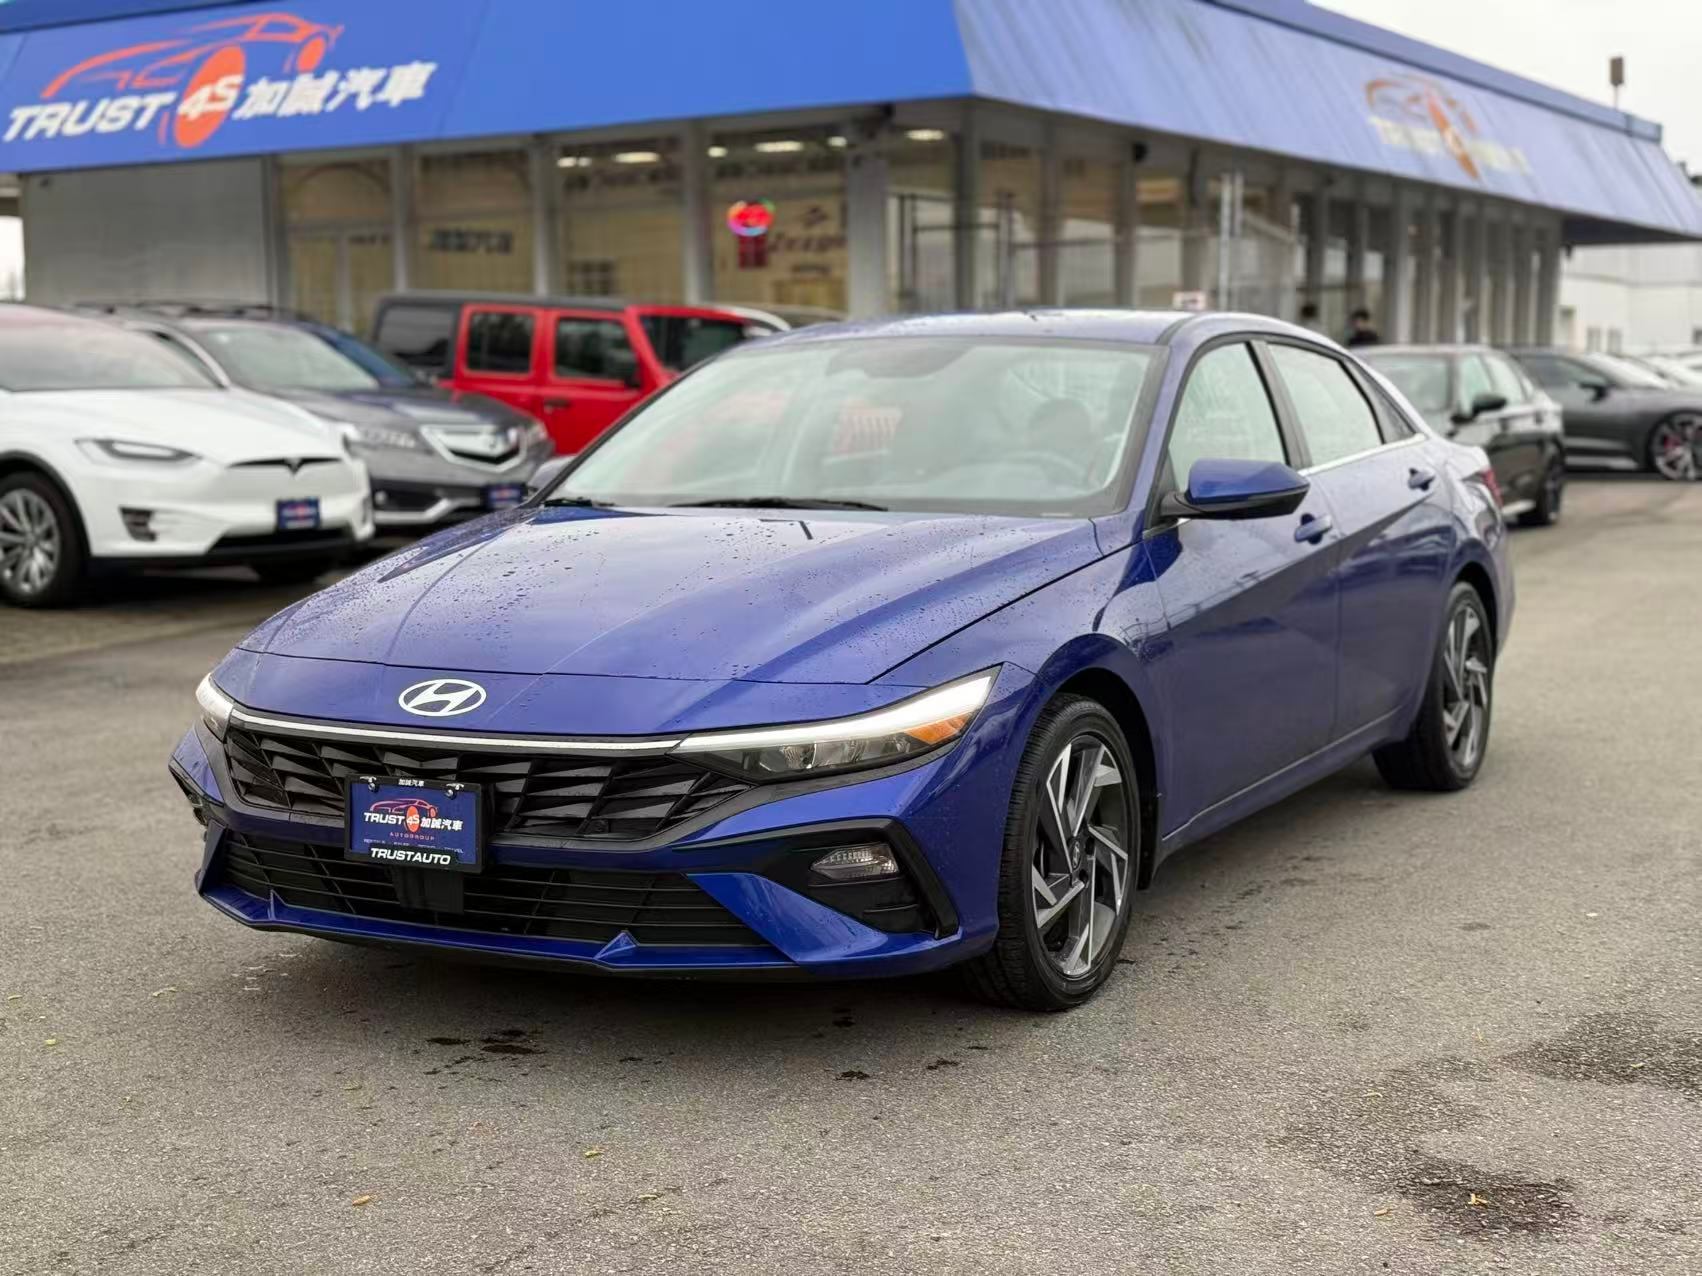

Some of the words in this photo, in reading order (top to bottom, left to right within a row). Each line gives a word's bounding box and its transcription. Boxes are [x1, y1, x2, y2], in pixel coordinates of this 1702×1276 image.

[4, 93, 176, 142] TRUST
[178, 74, 244, 120] 4S
[364, 812, 404, 824] TRUST
[406, 814, 420, 826] 4S
[390, 832, 435, 840] AUTOGROUP
[371, 848, 450, 864] TRUSTAUTO
